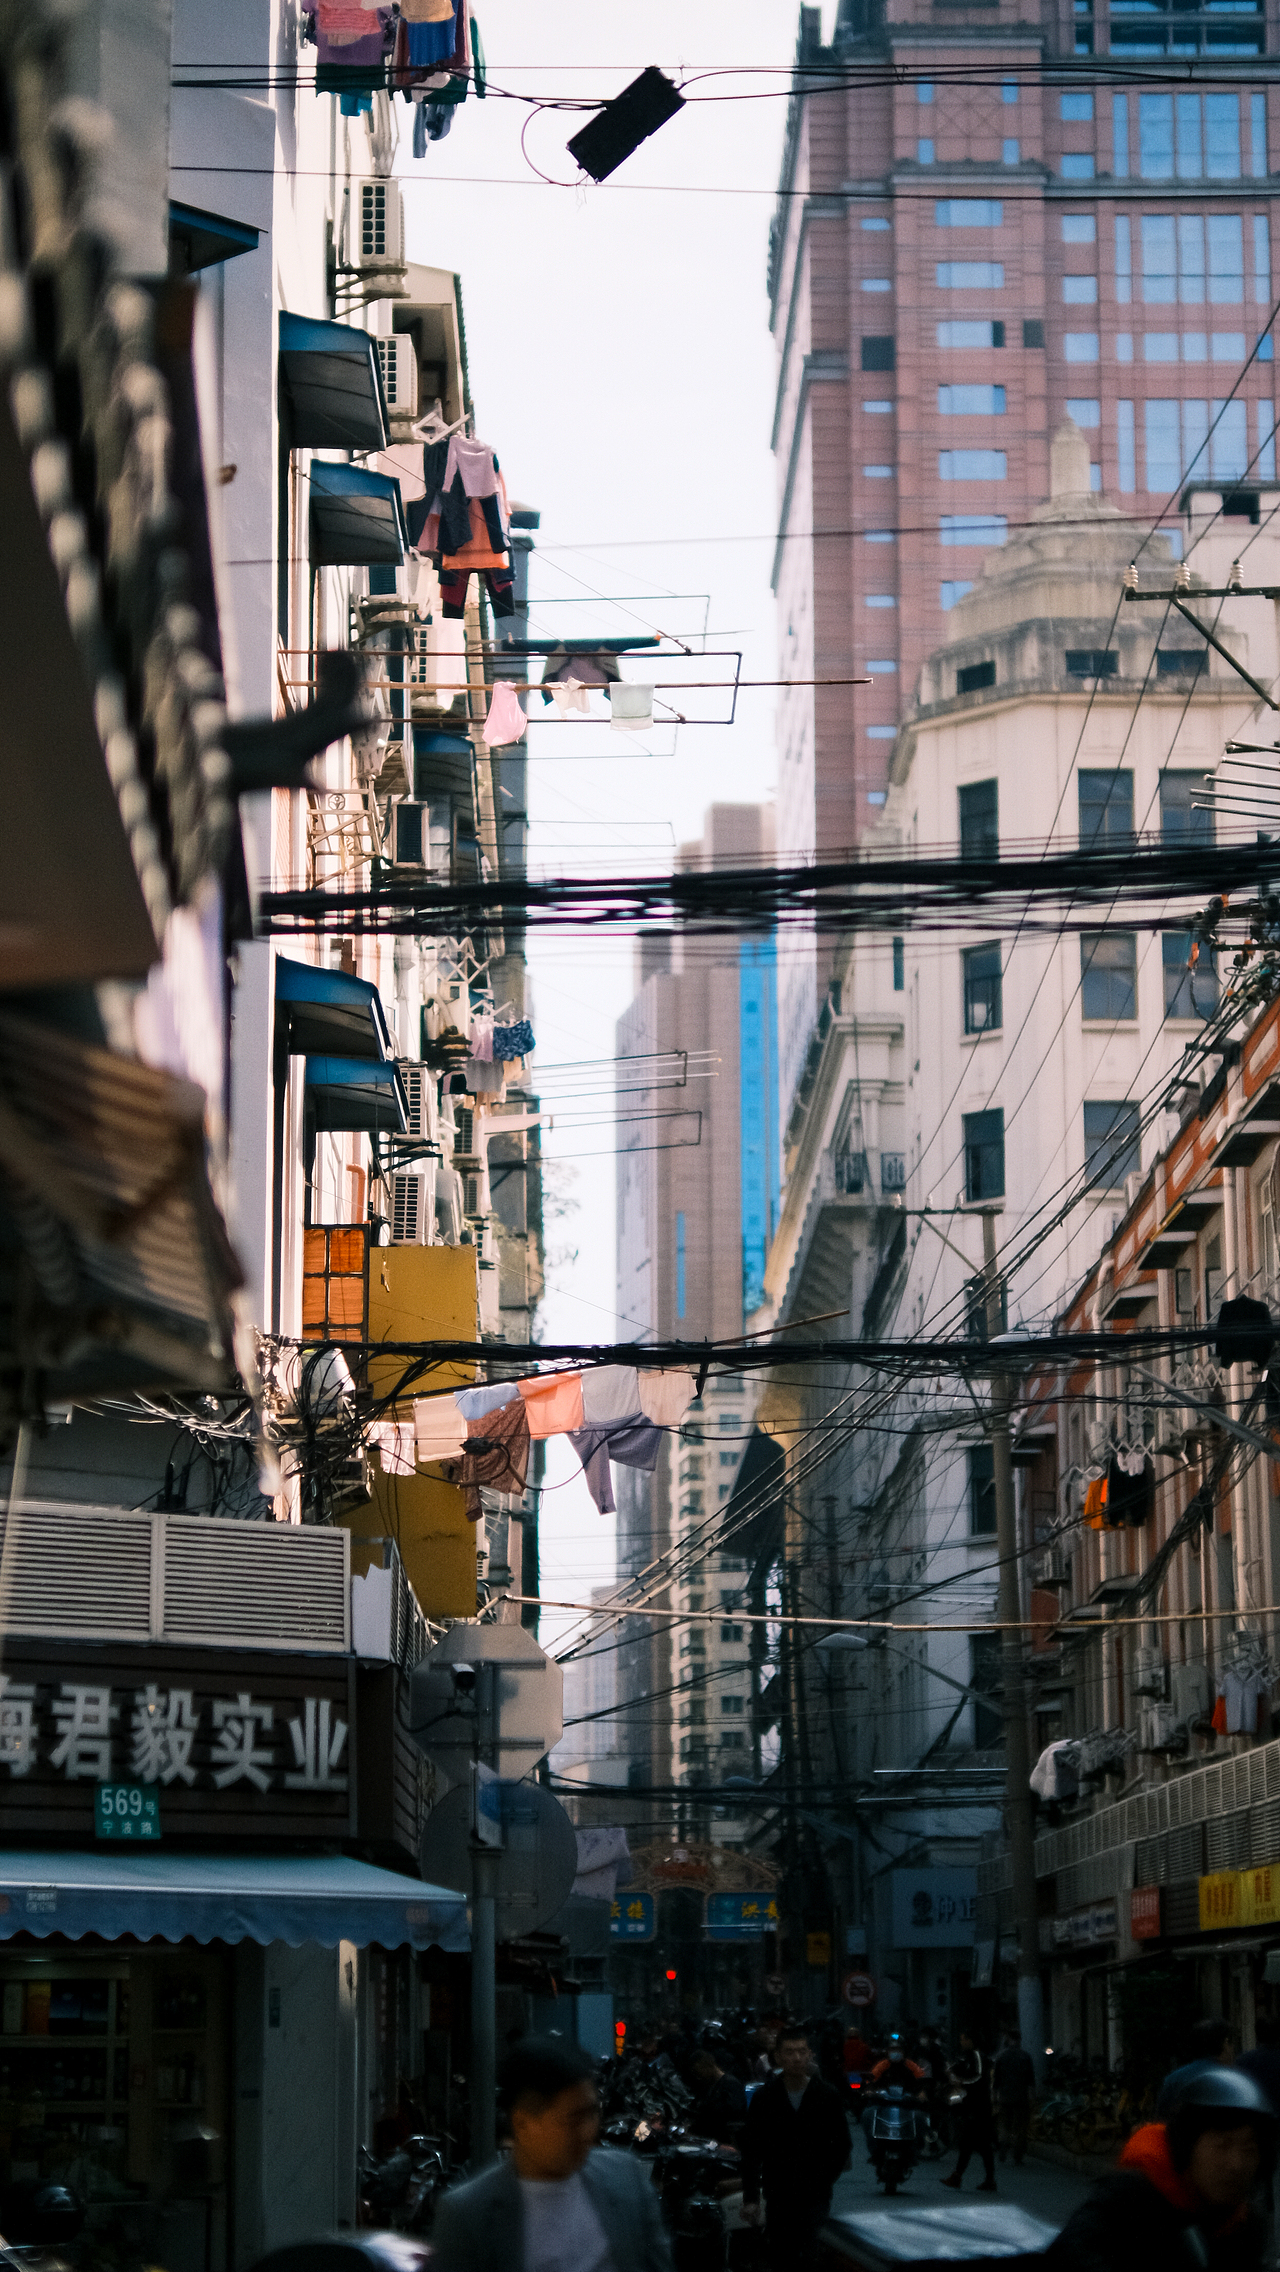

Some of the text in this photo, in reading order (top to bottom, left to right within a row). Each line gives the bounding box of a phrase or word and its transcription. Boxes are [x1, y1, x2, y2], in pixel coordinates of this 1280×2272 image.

[101, 1788, 155, 1816] 569号
[102, 1821, 152, 1835] 宁波路
